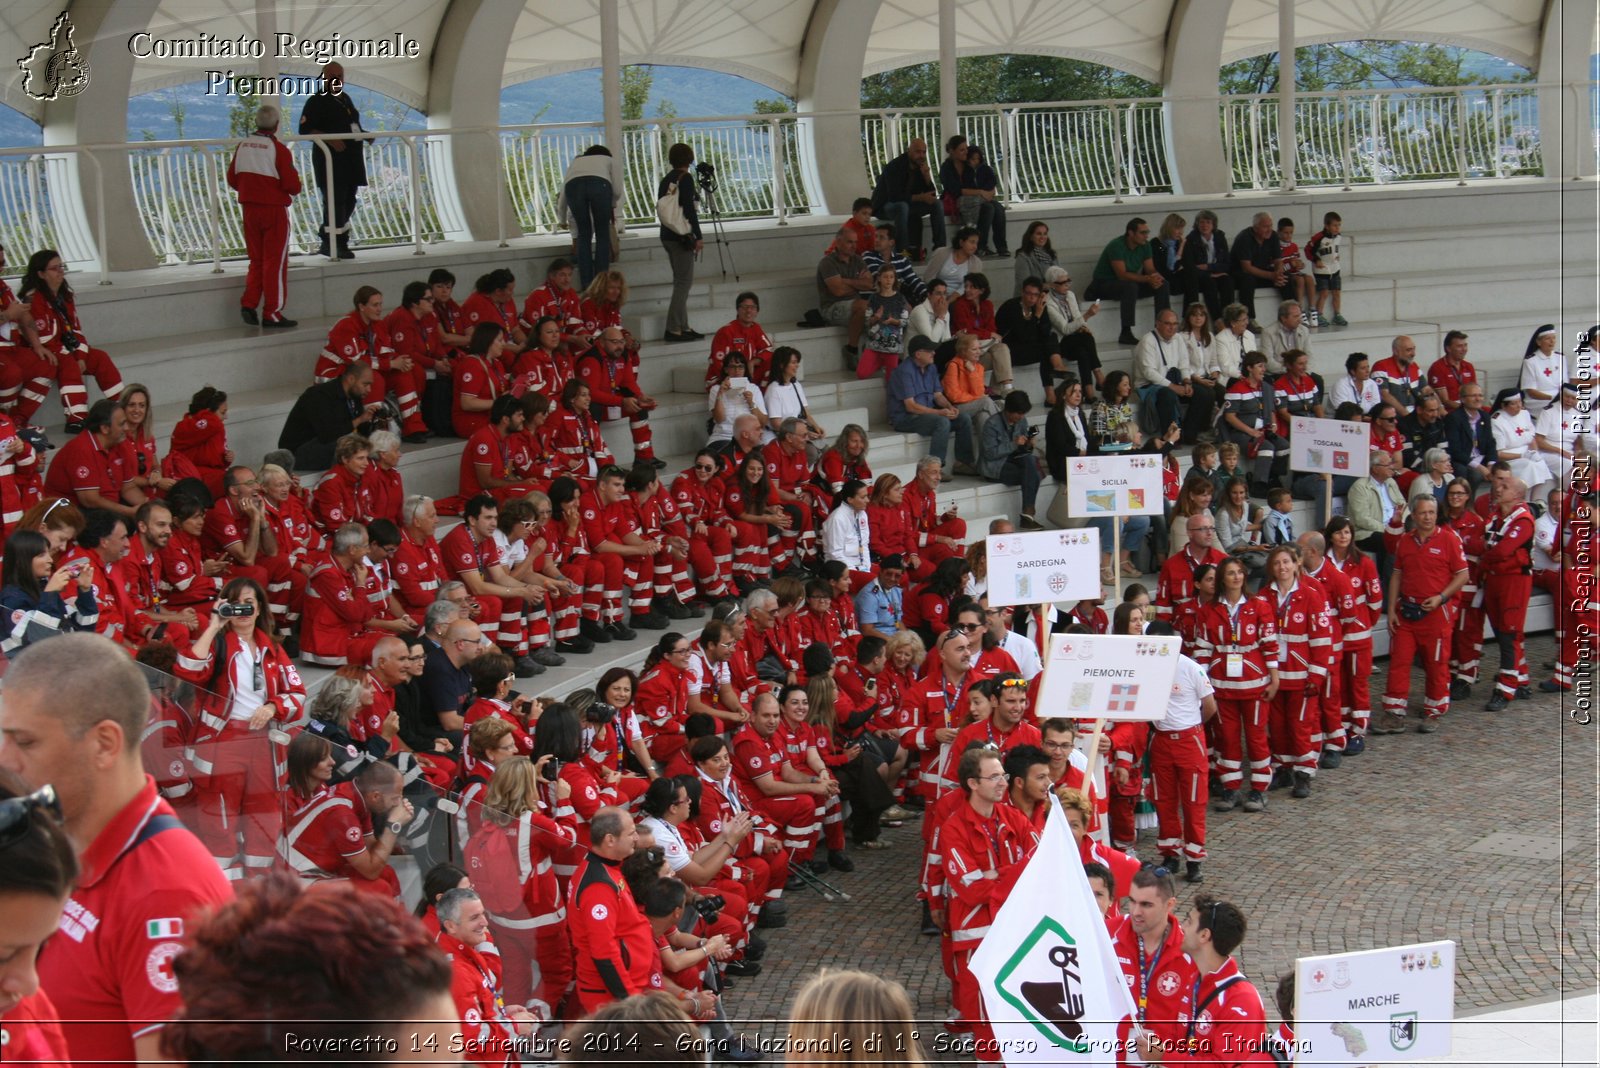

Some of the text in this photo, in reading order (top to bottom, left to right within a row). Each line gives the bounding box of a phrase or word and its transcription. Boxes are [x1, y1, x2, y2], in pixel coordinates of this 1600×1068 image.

[1313, 439, 1344, 448] TOSCANA
[1101, 478, 1128, 486] SICILIA
[1016, 558, 1067, 569] SARDEGNA
[1082, 668, 1136, 678] PIEMONTE
[1348, 993, 1401, 1011] MARCHE
